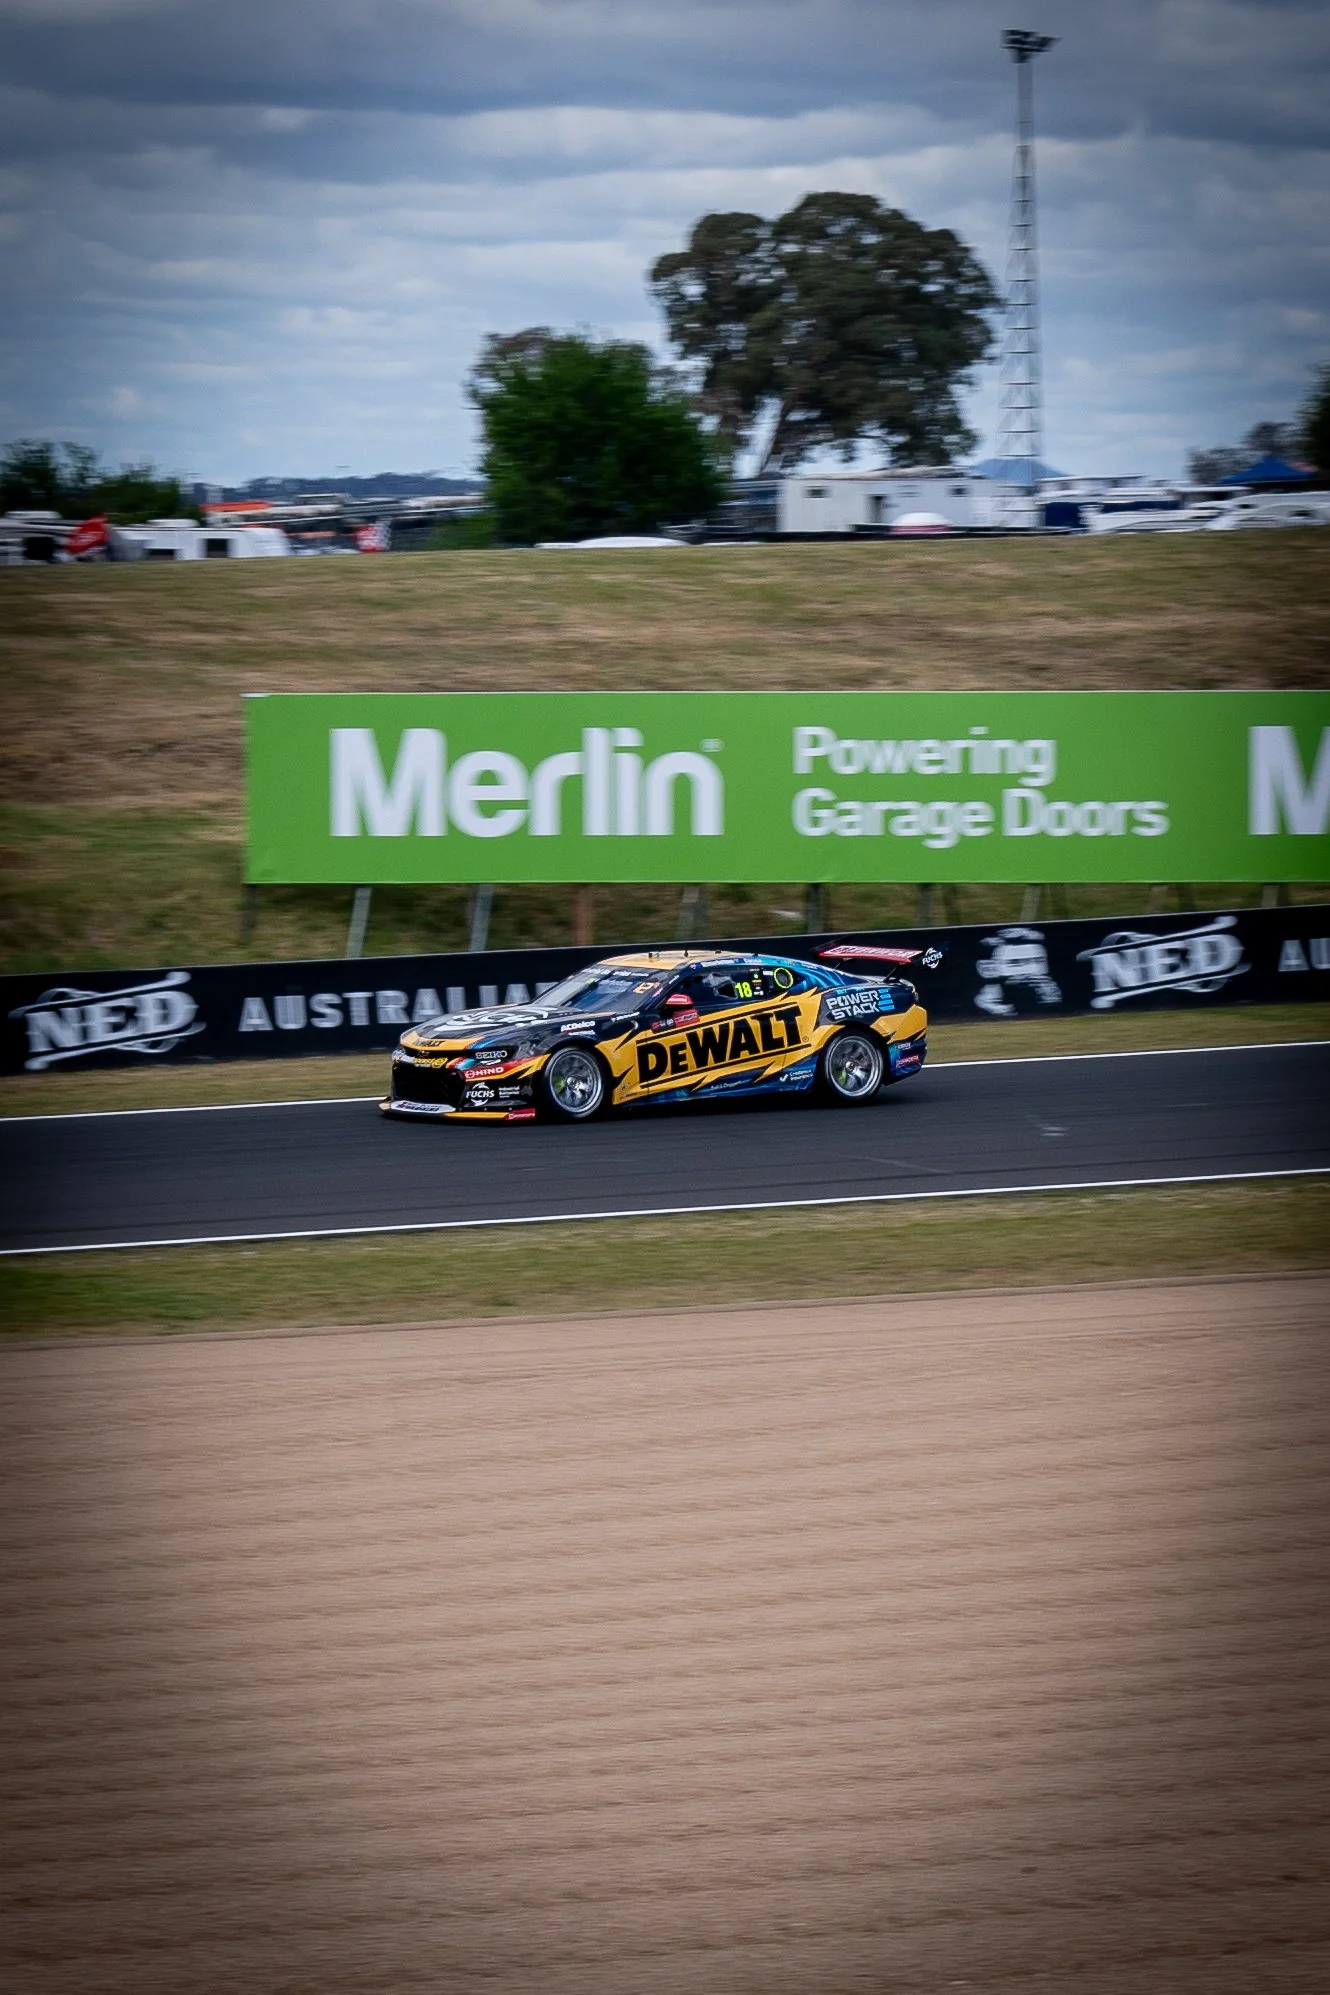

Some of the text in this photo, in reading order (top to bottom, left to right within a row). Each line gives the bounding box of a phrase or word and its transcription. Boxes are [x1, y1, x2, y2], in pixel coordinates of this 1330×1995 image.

[792, 726, 1057, 786] Powering
[329, 727, 724, 838] Merlin
[1247, 725, 1330, 836] M
[791, 788, 1170, 849] Garage Doors
[1090, 933, 1245, 993] NED
[735, 981, 752, 999] 18
[826, 989, 880, 1011] POWER
[25, 990, 199, 1053] NED
[831, 1002, 880, 1020] STACK
[475, 1050, 508, 1059] SEIKO
[475, 1067, 504, 1076] HINO
[466, 1090, 495, 1098] FUCHS
